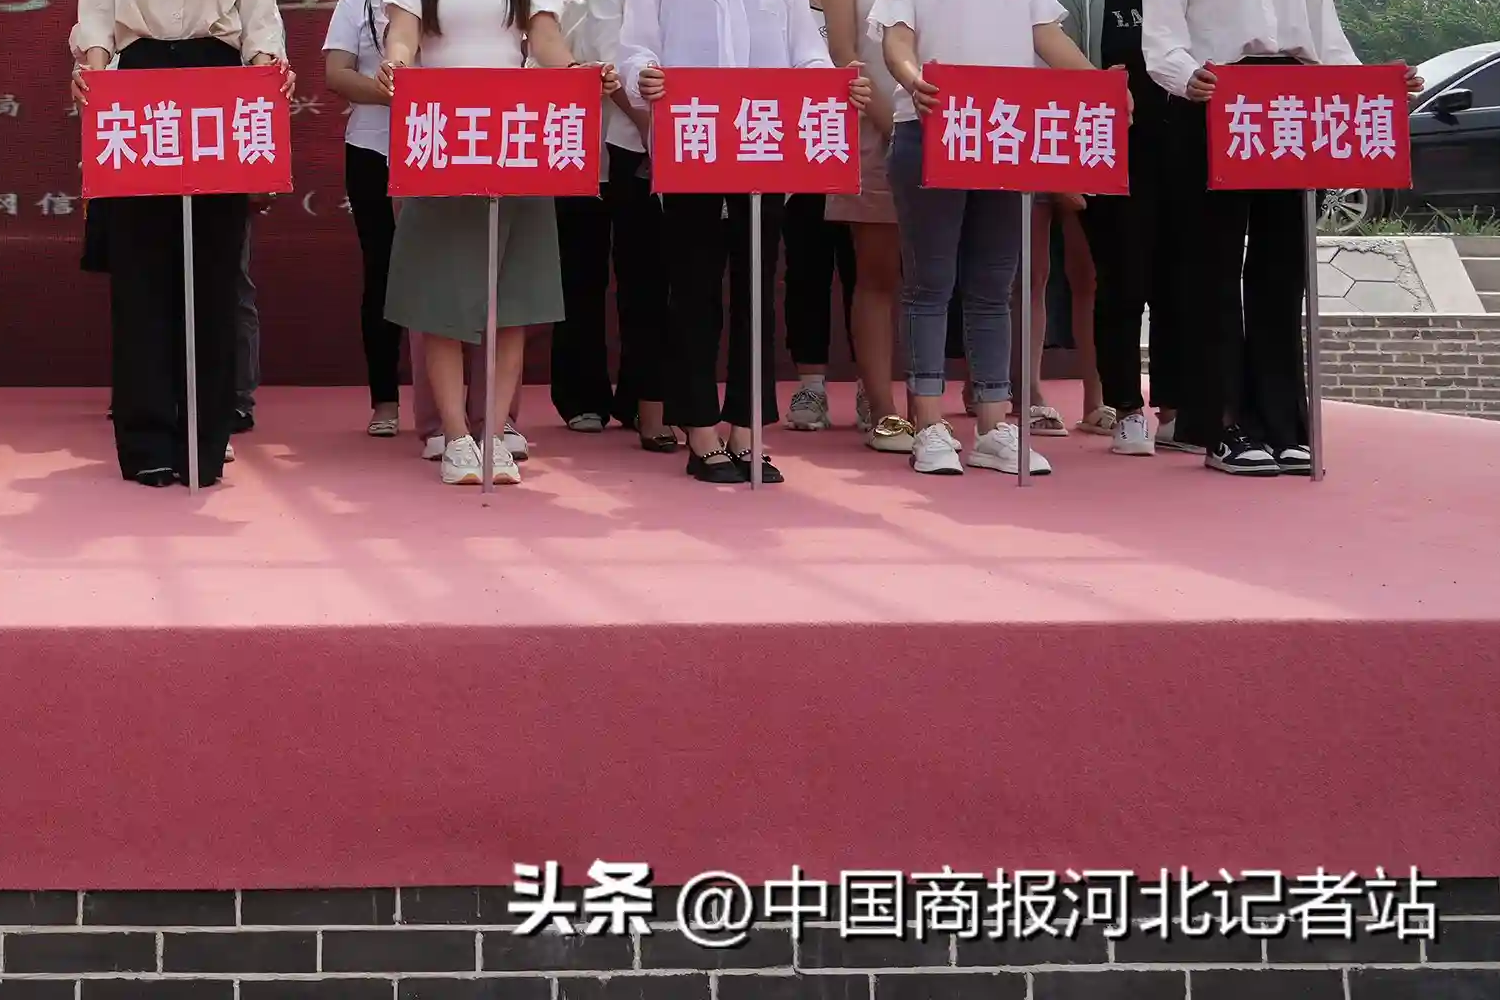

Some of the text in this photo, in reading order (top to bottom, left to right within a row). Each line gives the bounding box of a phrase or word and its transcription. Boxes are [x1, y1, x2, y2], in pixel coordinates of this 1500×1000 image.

[96, 96, 276, 170] 宋道口镇
[405, 102, 586, 170] 姚王庄镇
[670, 96, 849, 164] 南堡镇
[942, 96, 1116, 169] 柏各庄镇
[1225, 94, 1396, 160] 东黄坨镇
